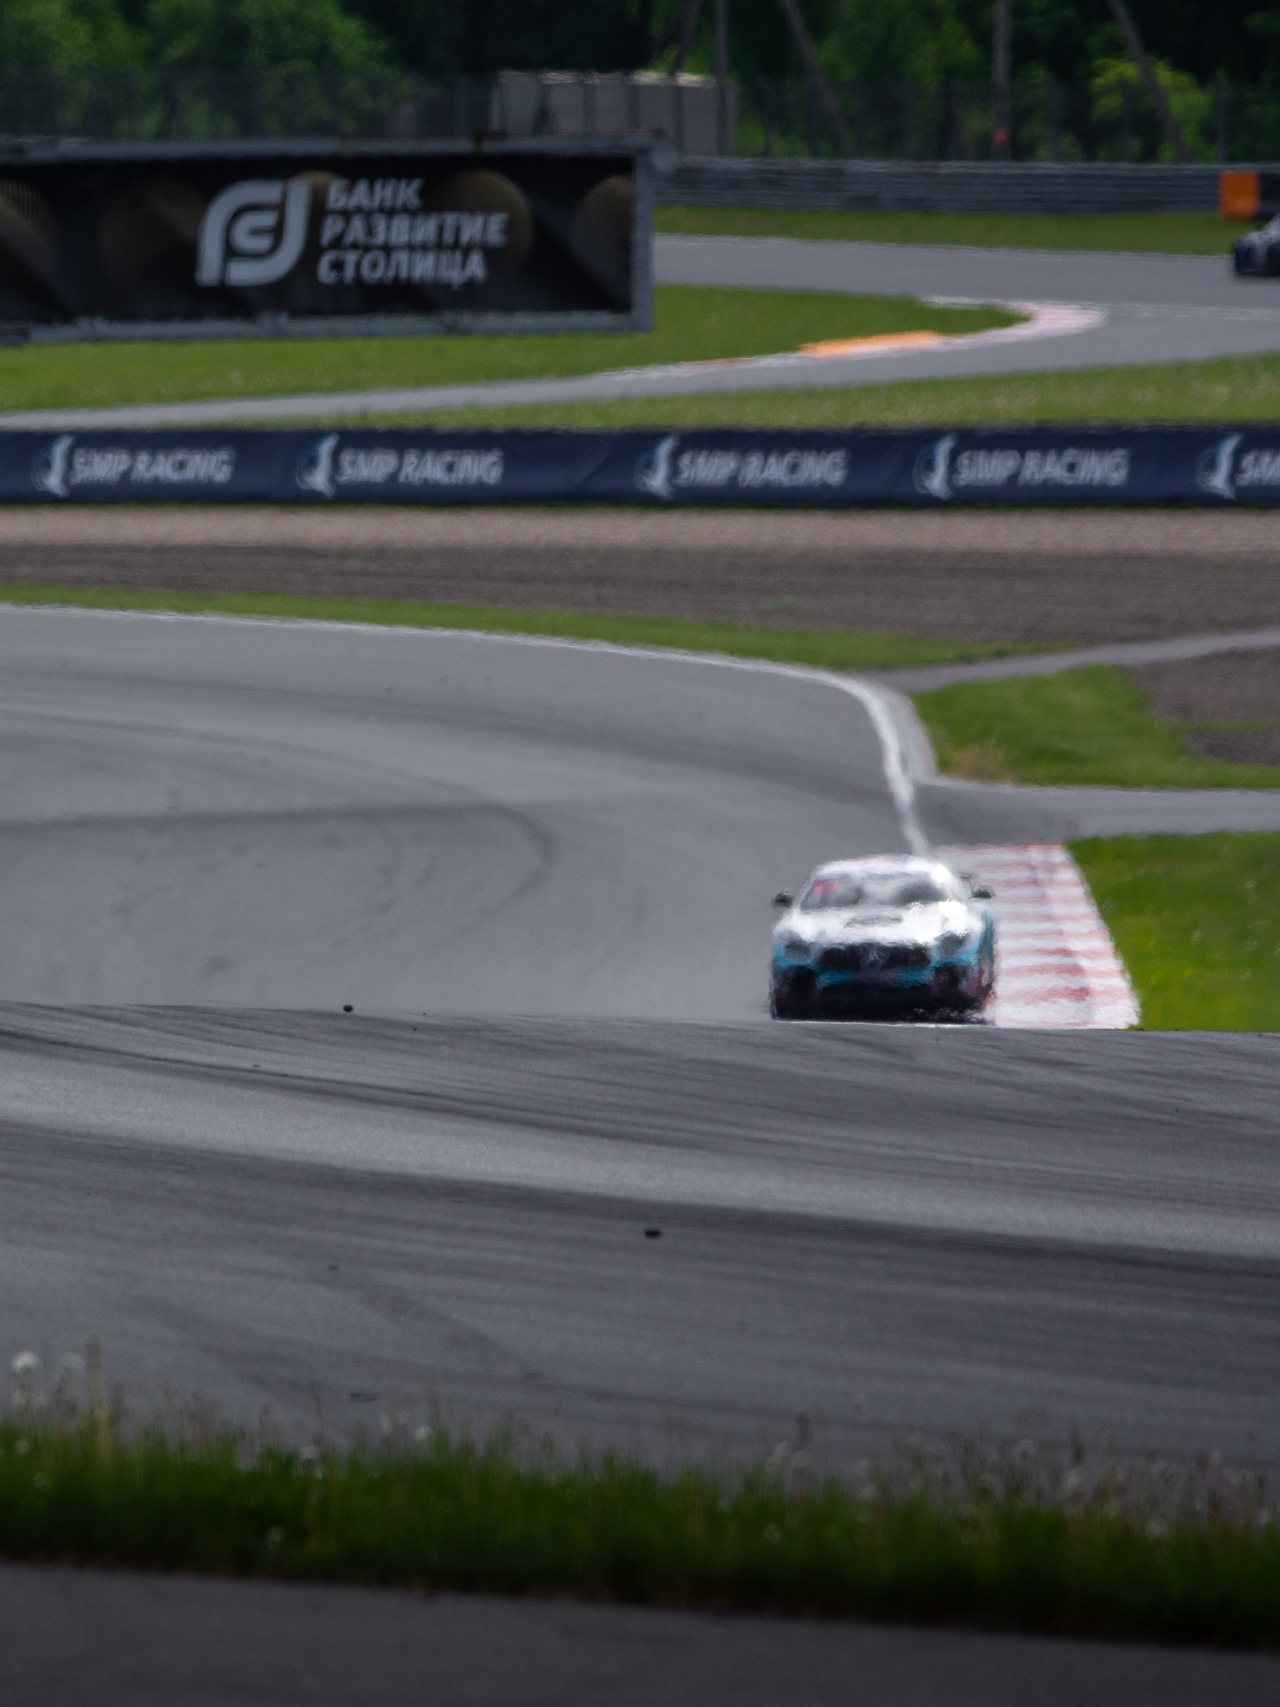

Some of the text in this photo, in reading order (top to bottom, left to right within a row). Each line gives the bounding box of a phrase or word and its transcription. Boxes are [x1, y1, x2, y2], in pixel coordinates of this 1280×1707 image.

[326, 177, 424, 211] БАНК
[320, 212, 509, 248] РАЗВИТИЕ
[317, 250, 488, 289] СТОЛИЦА
[70, 447, 234, 484] SMP RACING
[336, 448, 503, 485] SMP RACING
[674, 449, 848, 486] SMP RACING
[953, 449, 1130, 486] SMP RACING
